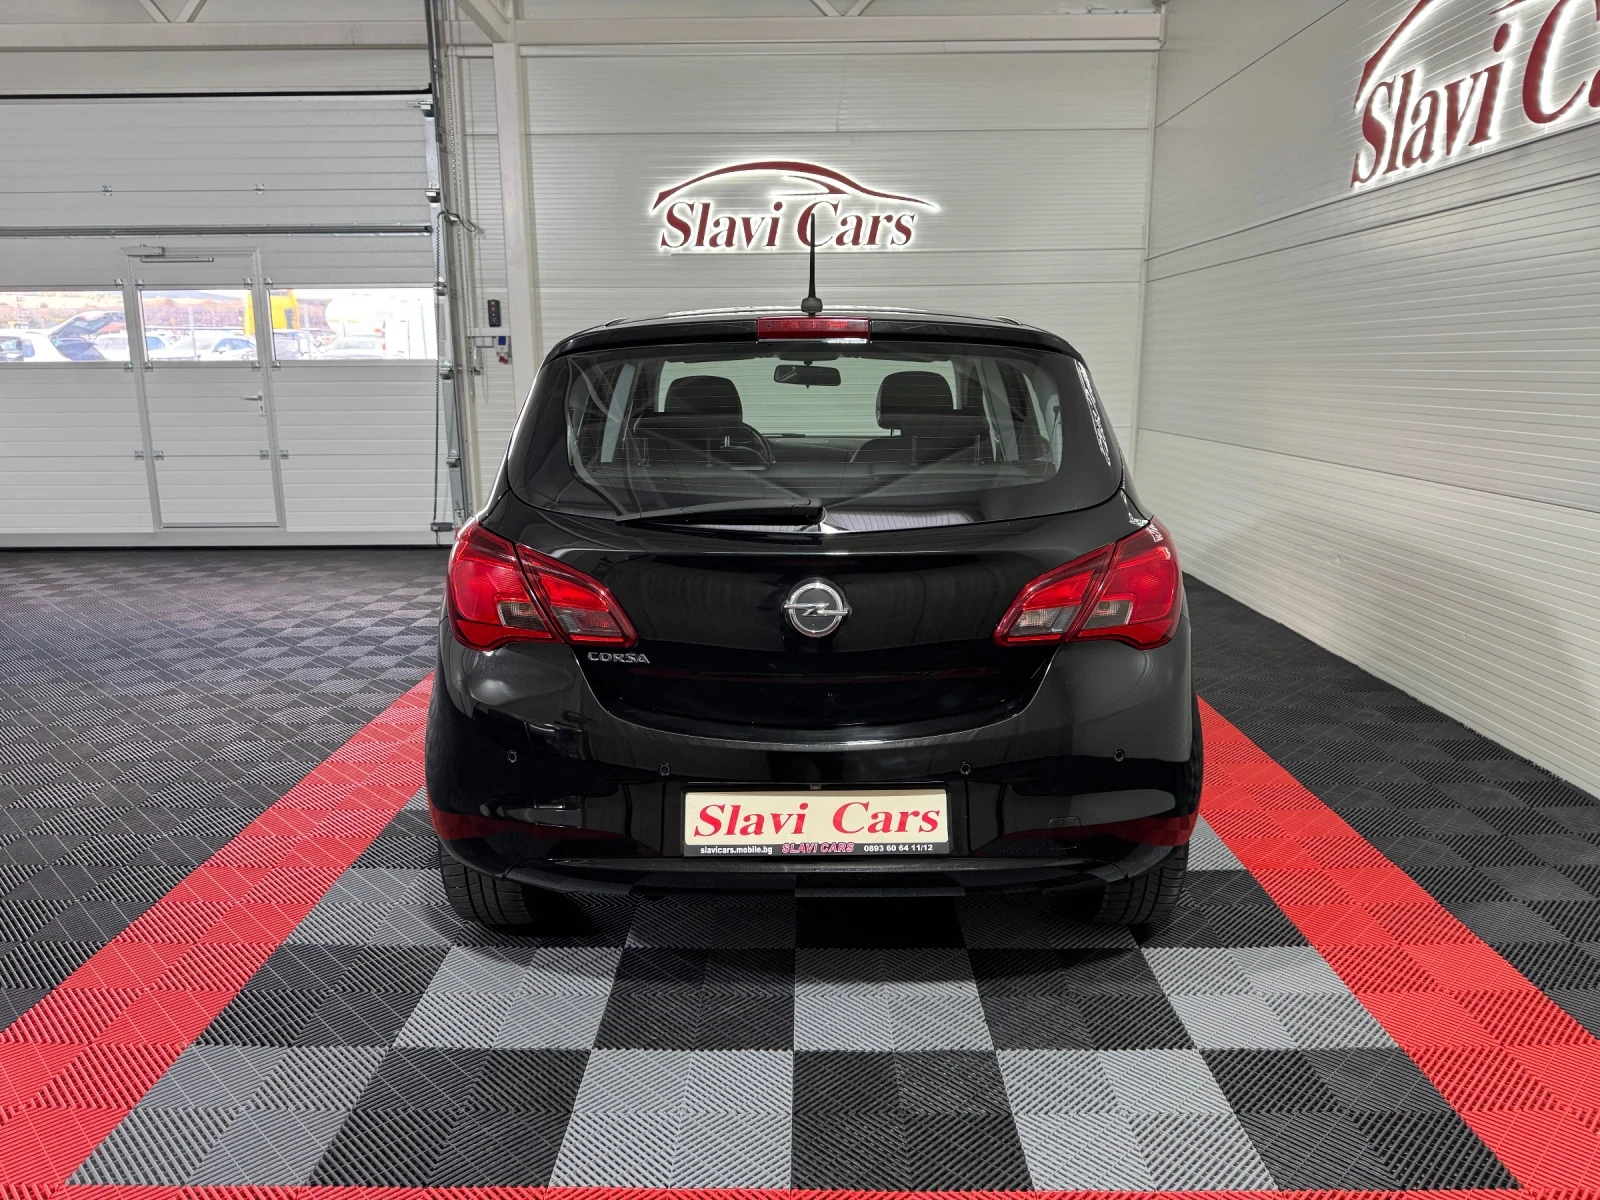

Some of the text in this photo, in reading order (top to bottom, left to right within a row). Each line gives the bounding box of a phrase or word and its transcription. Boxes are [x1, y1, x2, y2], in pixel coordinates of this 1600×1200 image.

[1350, 23, 1509, 188] Slavi
[660, 200, 916, 248] Slavi Cars
[587, 651, 650, 664] CORSA
[694, 801, 941, 837] Slavi Cars
[700, 842, 934, 855] slavicars.mobile.bg SLAVI CARS 0893 60 64 11/12
